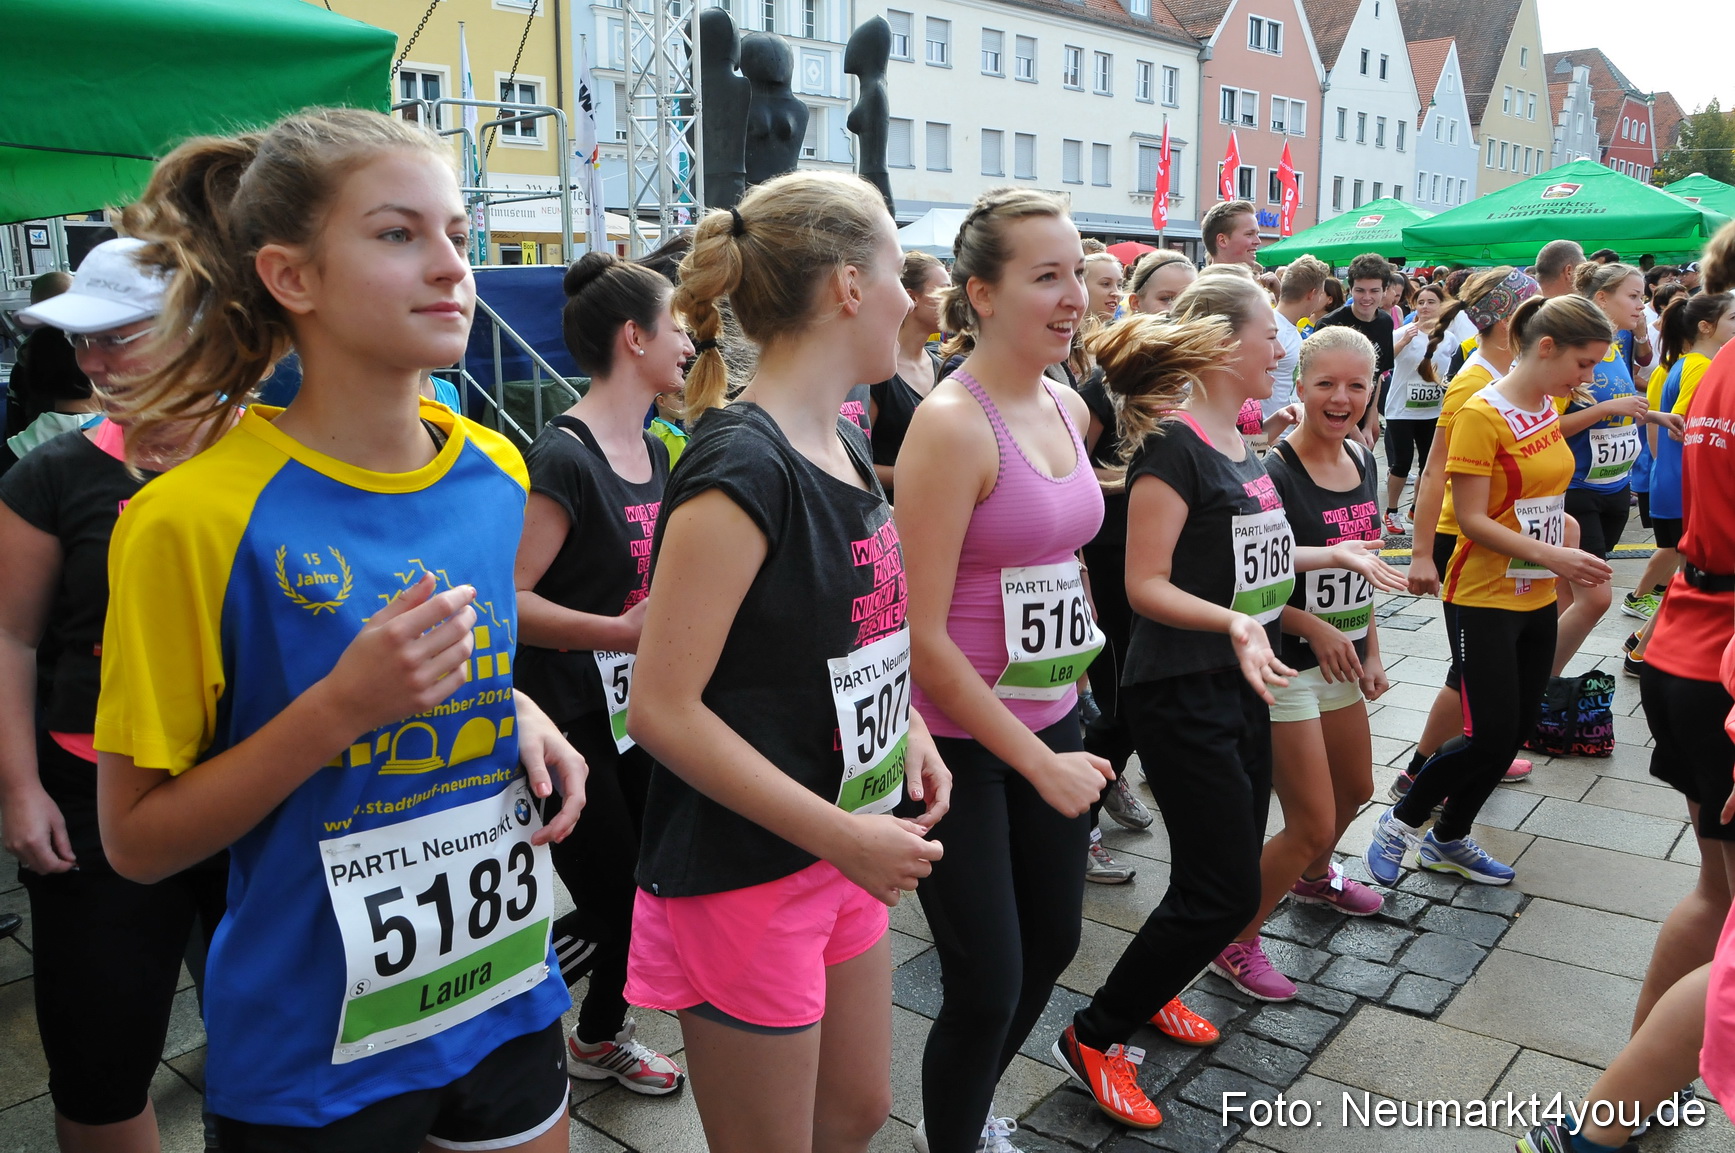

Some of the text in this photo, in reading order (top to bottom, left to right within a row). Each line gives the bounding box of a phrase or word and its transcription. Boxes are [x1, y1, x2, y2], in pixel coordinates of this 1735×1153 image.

[1486, 207, 1607, 220] Lammsbräu
[523, 242, 535, 250] Block
[526, 252, 533, 264] A
[1411, 388, 1440, 401] 5033
[1519, 436, 1551, 458] MAX
[1598, 438, 1636, 464] 5117
[626, 505, 648, 522] WIR
[1323, 502, 1377, 524] WIR SIND
[1517, 506, 1545, 516] PARTL
[1235, 526, 1263, 538] PARTL
[1339, 517, 1372, 535] ZWAR
[1528, 514, 1562, 546] 5131
[303, 553, 321, 565] 15
[1244, 535, 1291, 584] 5168
[297, 572, 339, 587] Jahre
[1005, 580, 1053, 594] PARTL
[1261, 590, 1277, 608] Lilli
[1327, 612, 1369, 630] Vanessa
[834, 665, 881, 694] PARTL
[1050, 664, 1074, 682] Lea
[477, 687, 511, 706] 2014
[330, 813, 513, 887] PARTL Neumarkt
[364, 841, 538, 977] 5183
[355, 982, 364, 995] S
[419, 961, 493, 1012] Laura
